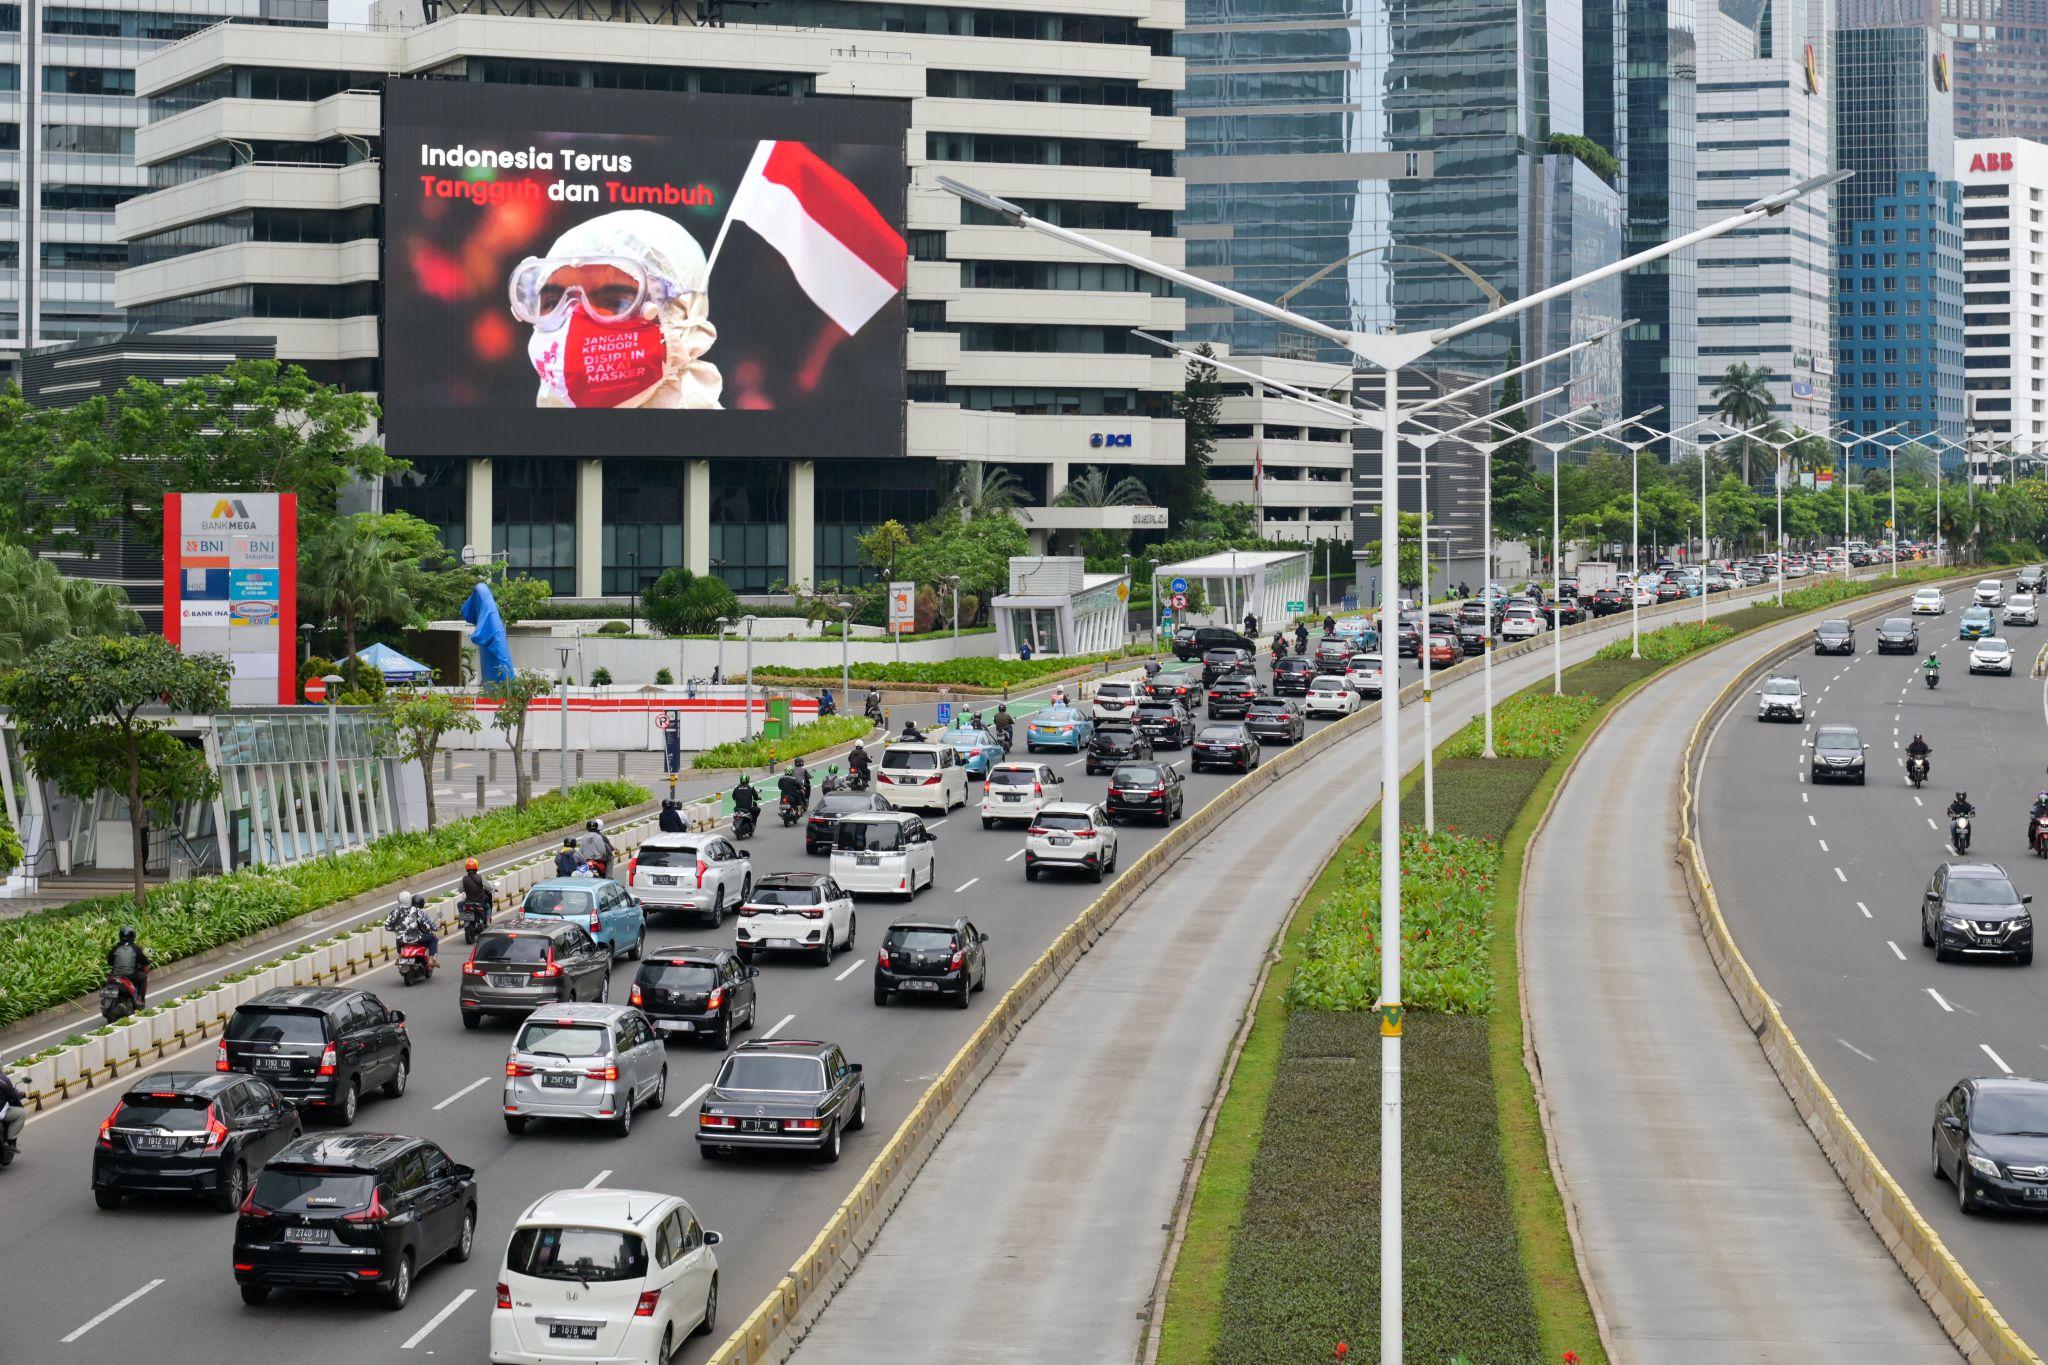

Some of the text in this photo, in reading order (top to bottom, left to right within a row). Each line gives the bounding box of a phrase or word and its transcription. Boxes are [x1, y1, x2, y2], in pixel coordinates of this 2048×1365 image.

[421, 144, 633, 173] Indonesia Terus
[1969, 152, 2014, 172] ABB
[420, 175, 715, 206] Tangguh dan Tumbuh
[584, 349, 645, 366] DISIPLIN
[587, 367, 646, 383] MASKER
[200, 541, 223, 552] BNI
[250, 541, 274, 552] BNI
[286, 1228, 291, 1236] B
[551, 1325, 596, 1336] B 1678 NMP
